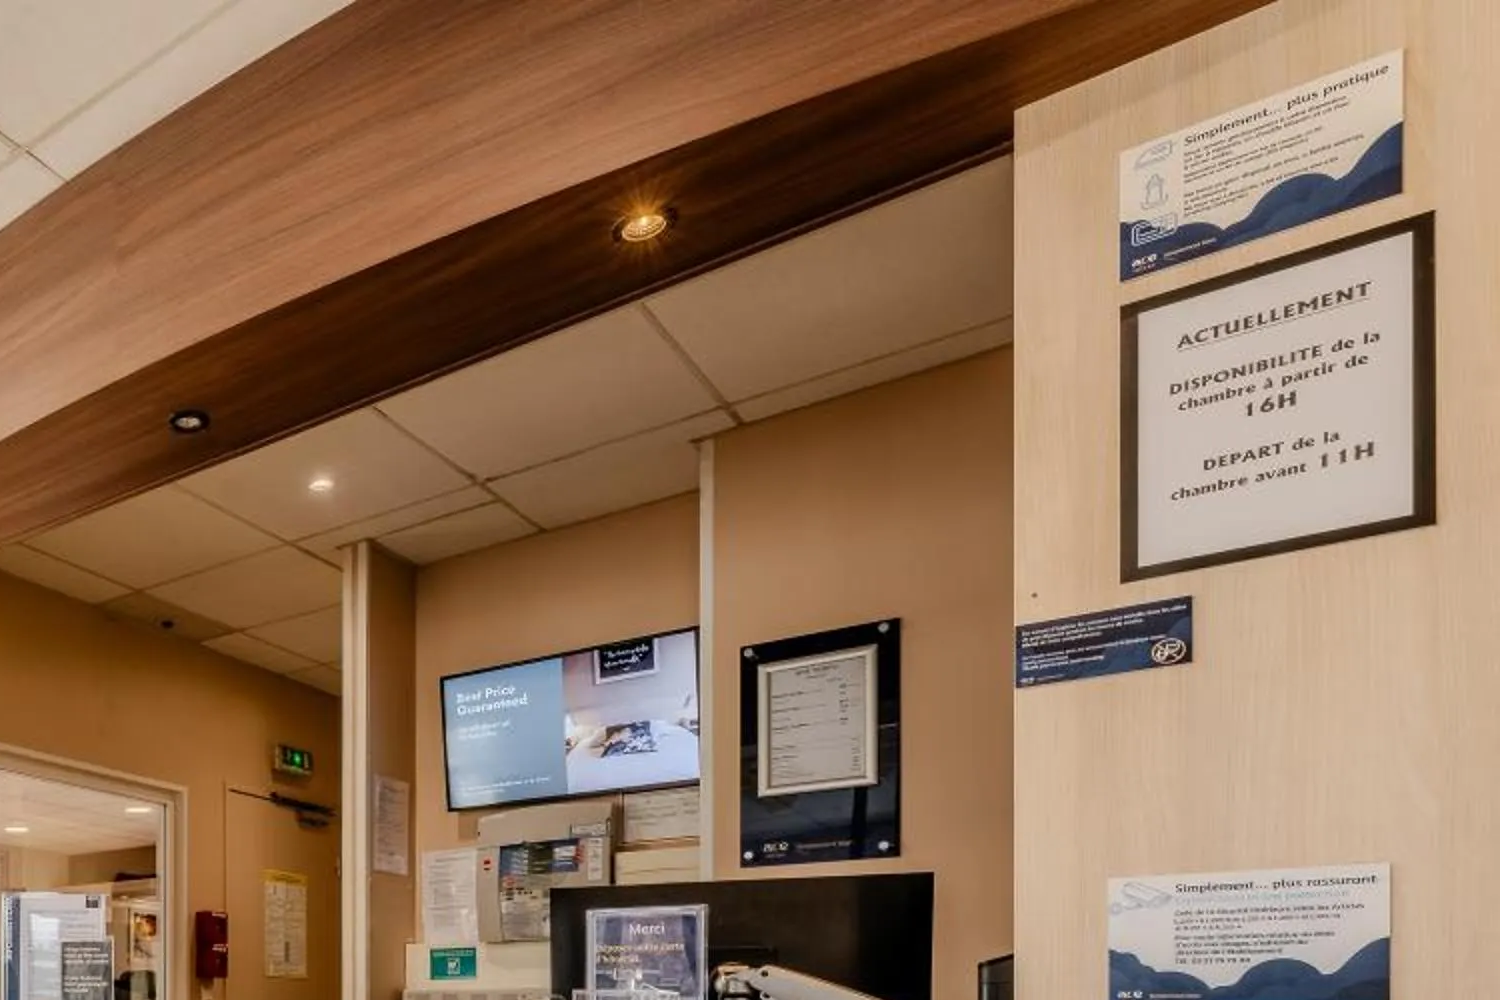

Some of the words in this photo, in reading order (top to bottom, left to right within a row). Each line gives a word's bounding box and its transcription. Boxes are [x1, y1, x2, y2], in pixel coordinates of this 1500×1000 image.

[1286, 91, 1318, 111] plus
[1323, 65, 1390, 98] pratique
[1177, 281, 1372, 349] ACTUELLEMENT
[1169, 345, 1322, 395] DISPONIBILITE
[1331, 338, 1355, 353] de
[1363, 331, 1380, 344] la
[1178, 381, 1256, 411] chambre
[1264, 377, 1273, 390] à
[1281, 362, 1337, 388] partir
[1345, 354, 1369, 369] de
[1246, 391, 1298, 417] 16H
[1171, 475, 1248, 501] chambre
[1255, 462, 1307, 482] avant
[1320, 441, 1375, 469] 11H
[1203, 441, 1285, 471] DEPART
[1292, 436, 1315, 451] de
[1323, 430, 1340, 443] la
[1272, 879, 1302, 890] plus
[1307, 875, 1377, 887] rassurant
[629, 921, 666, 936] Merci
